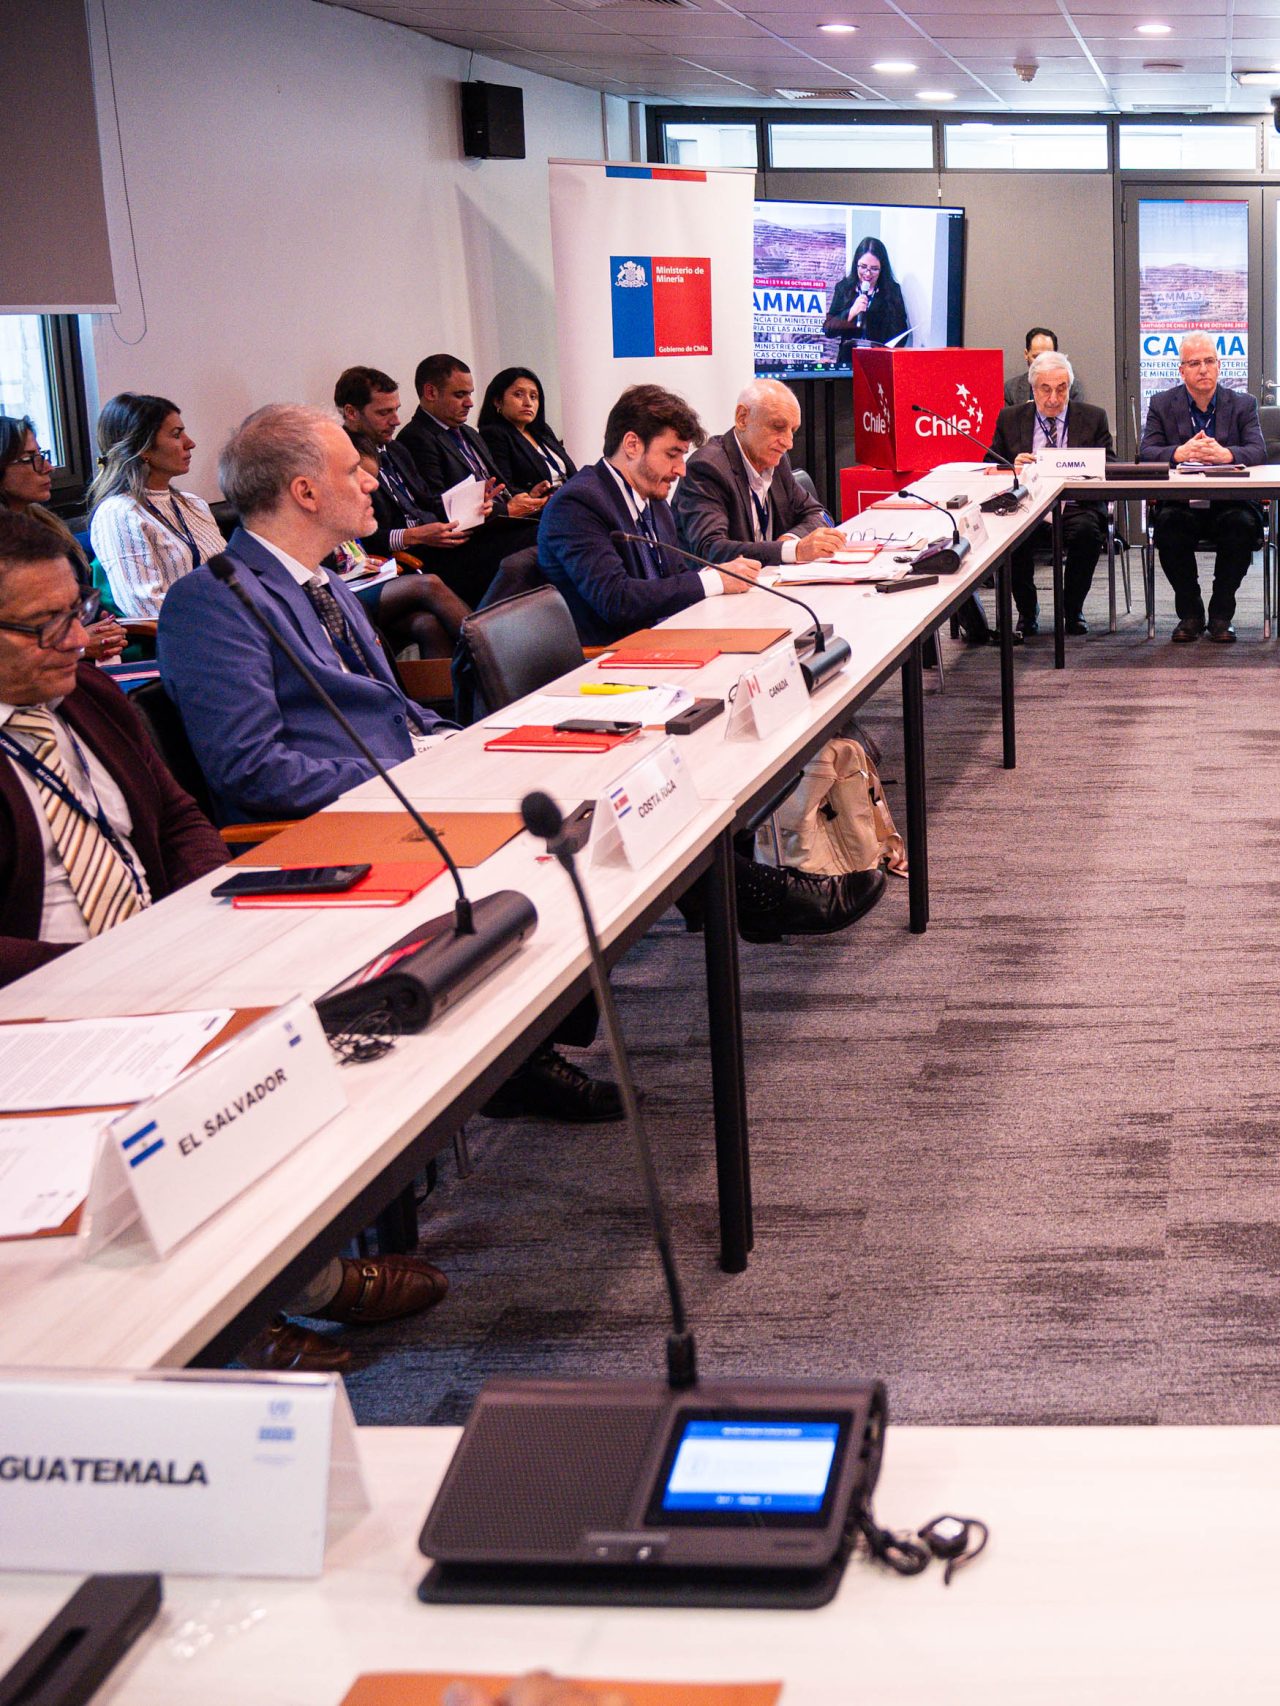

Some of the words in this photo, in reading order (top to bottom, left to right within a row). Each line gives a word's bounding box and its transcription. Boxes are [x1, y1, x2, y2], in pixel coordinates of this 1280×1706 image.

[656, 266, 693, 274] Ministerio
[753, 292, 823, 313] AMMA
[771, 351, 819, 359] CONFERENCE
[862, 411, 887, 435] Chile
[914, 414, 972, 437] Chile
[768, 678, 789, 698] CANADA
[638, 793, 660, 818] COSTA
[660, 779, 677, 799] RICA
[177, 1132, 202, 1157] EL
[203, 1068, 287, 1137] SALVADOR
[0, 1455, 209, 1485] GUATEMALA
